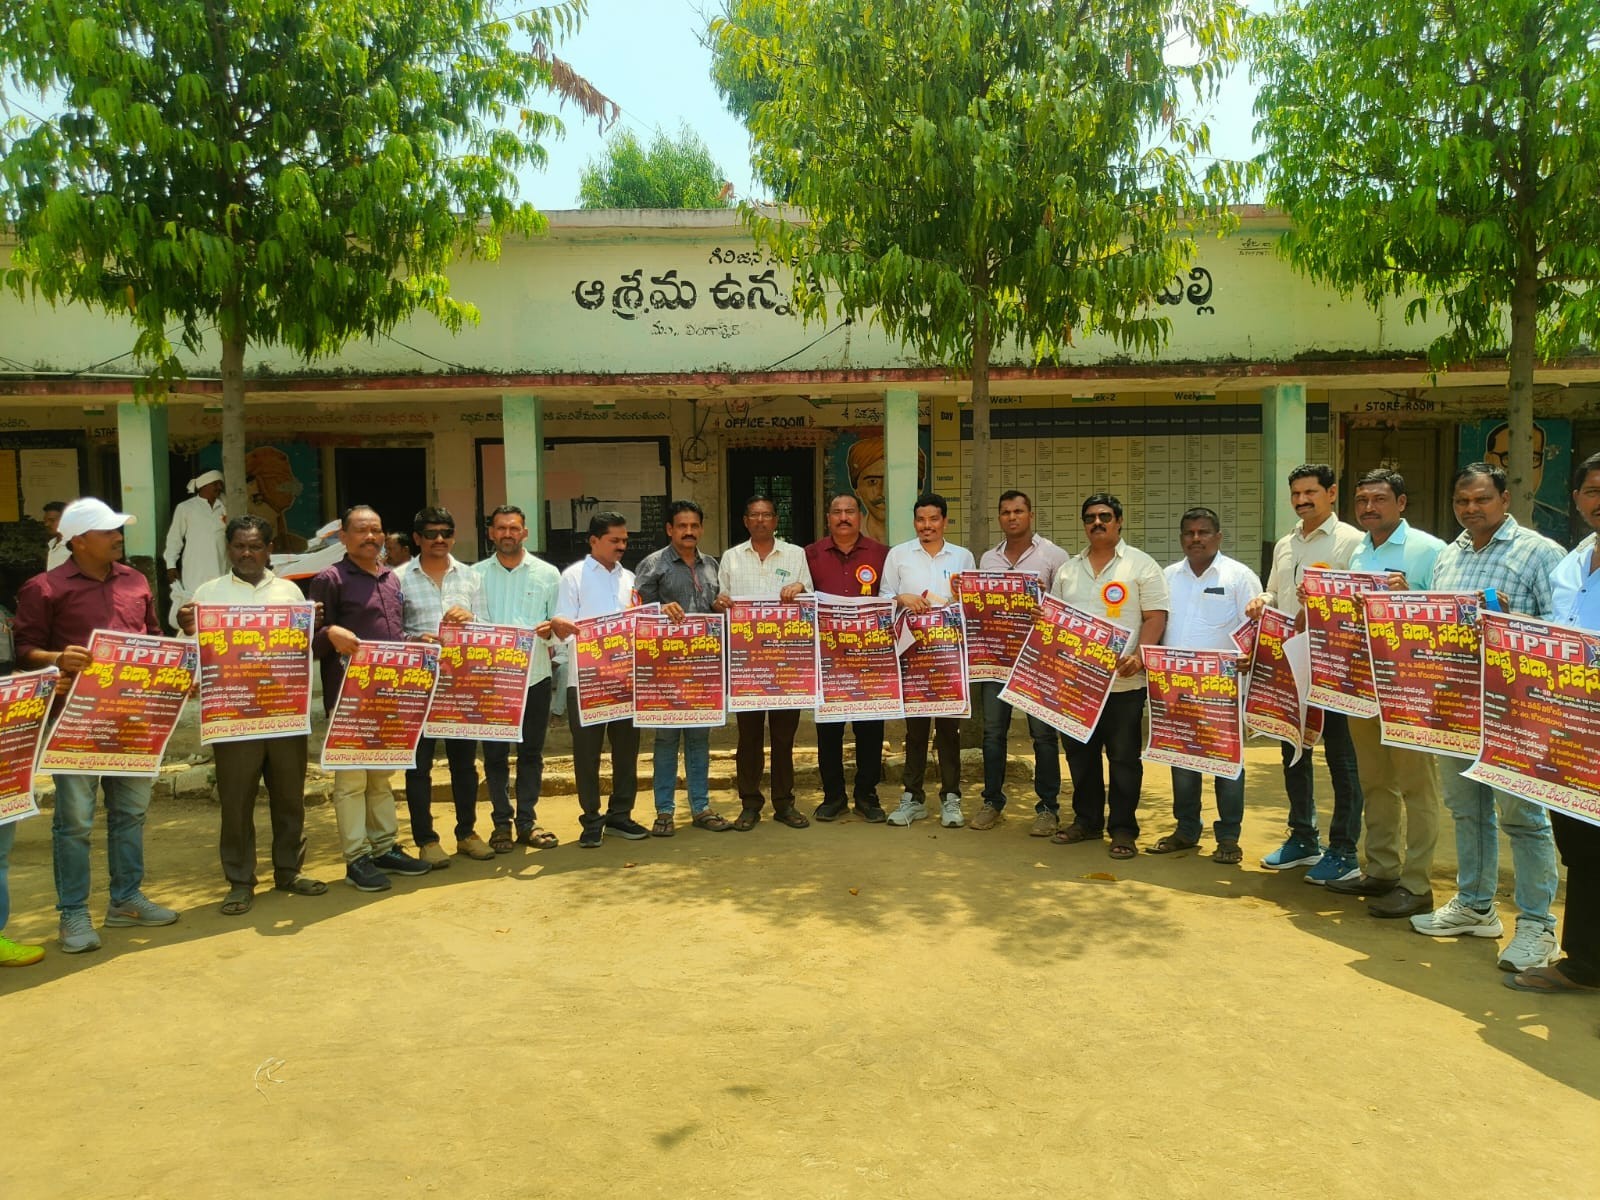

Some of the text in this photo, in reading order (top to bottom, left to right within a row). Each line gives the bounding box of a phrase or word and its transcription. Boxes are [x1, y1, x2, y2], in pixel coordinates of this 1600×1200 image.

[976, 580, 1022, 592] TPTF
[748, 608, 798, 619] TPTF
[1388, 604, 1455, 620] TPTF
[222, 613, 287, 626] TPTF
[830, 617, 876, 630] TPTF
[909, 615, 940, 626] PTF
[1054, 609, 1110, 641] TPTF
[653, 624, 704, 636] TPTF
[458, 631, 515, 646] TPTF
[1504, 630, 1580, 660] TPTF
[117, 646, 180, 664] TPTF
[371, 651, 421, 665] TPTF
[1162, 658, 1216, 672] TPTF
